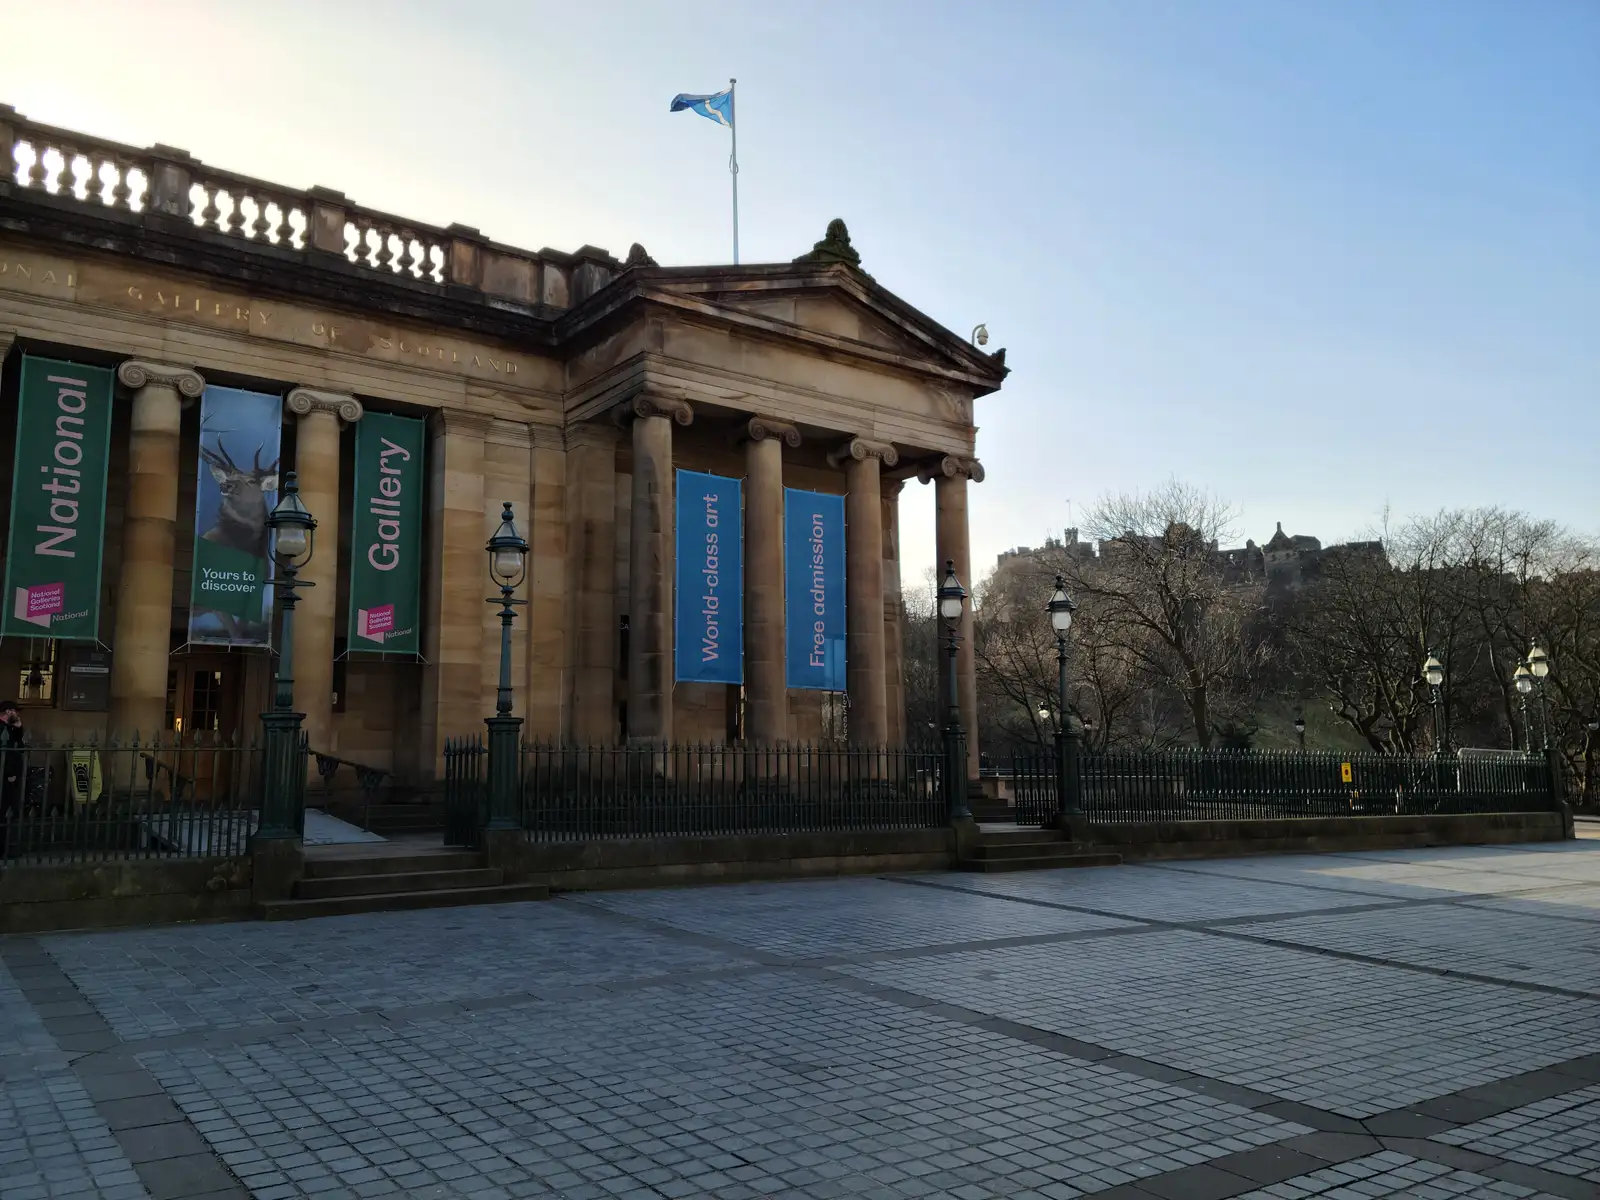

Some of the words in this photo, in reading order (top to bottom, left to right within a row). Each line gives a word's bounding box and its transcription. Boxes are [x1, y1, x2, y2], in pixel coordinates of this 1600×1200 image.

[128, 286, 273, 325] GALLERY
[311, 322, 343, 340] OF
[379, 336, 518, 374] SCOTLAND
[34, 374, 88, 558] National
[367, 436, 411, 571] Gallery
[703, 493, 719, 528] art
[809, 513, 825, 616] admission
[202, 567, 240, 580] Yours
[242, 570, 256, 582] to
[31, 588, 61, 598] National
[201, 579, 256, 593] discover
[30, 595, 61, 605] Galleries
[702, 532, 719, 662] World-class
[30, 601, 61, 611] Scotland
[52, 609, 89, 623] National
[369, 609, 392, 619] National
[369, 616, 392, 625] Galleries
[368, 621, 392, 630] Scotland
[385, 627, 412, 639] National
[810, 621, 825, 667] Free
